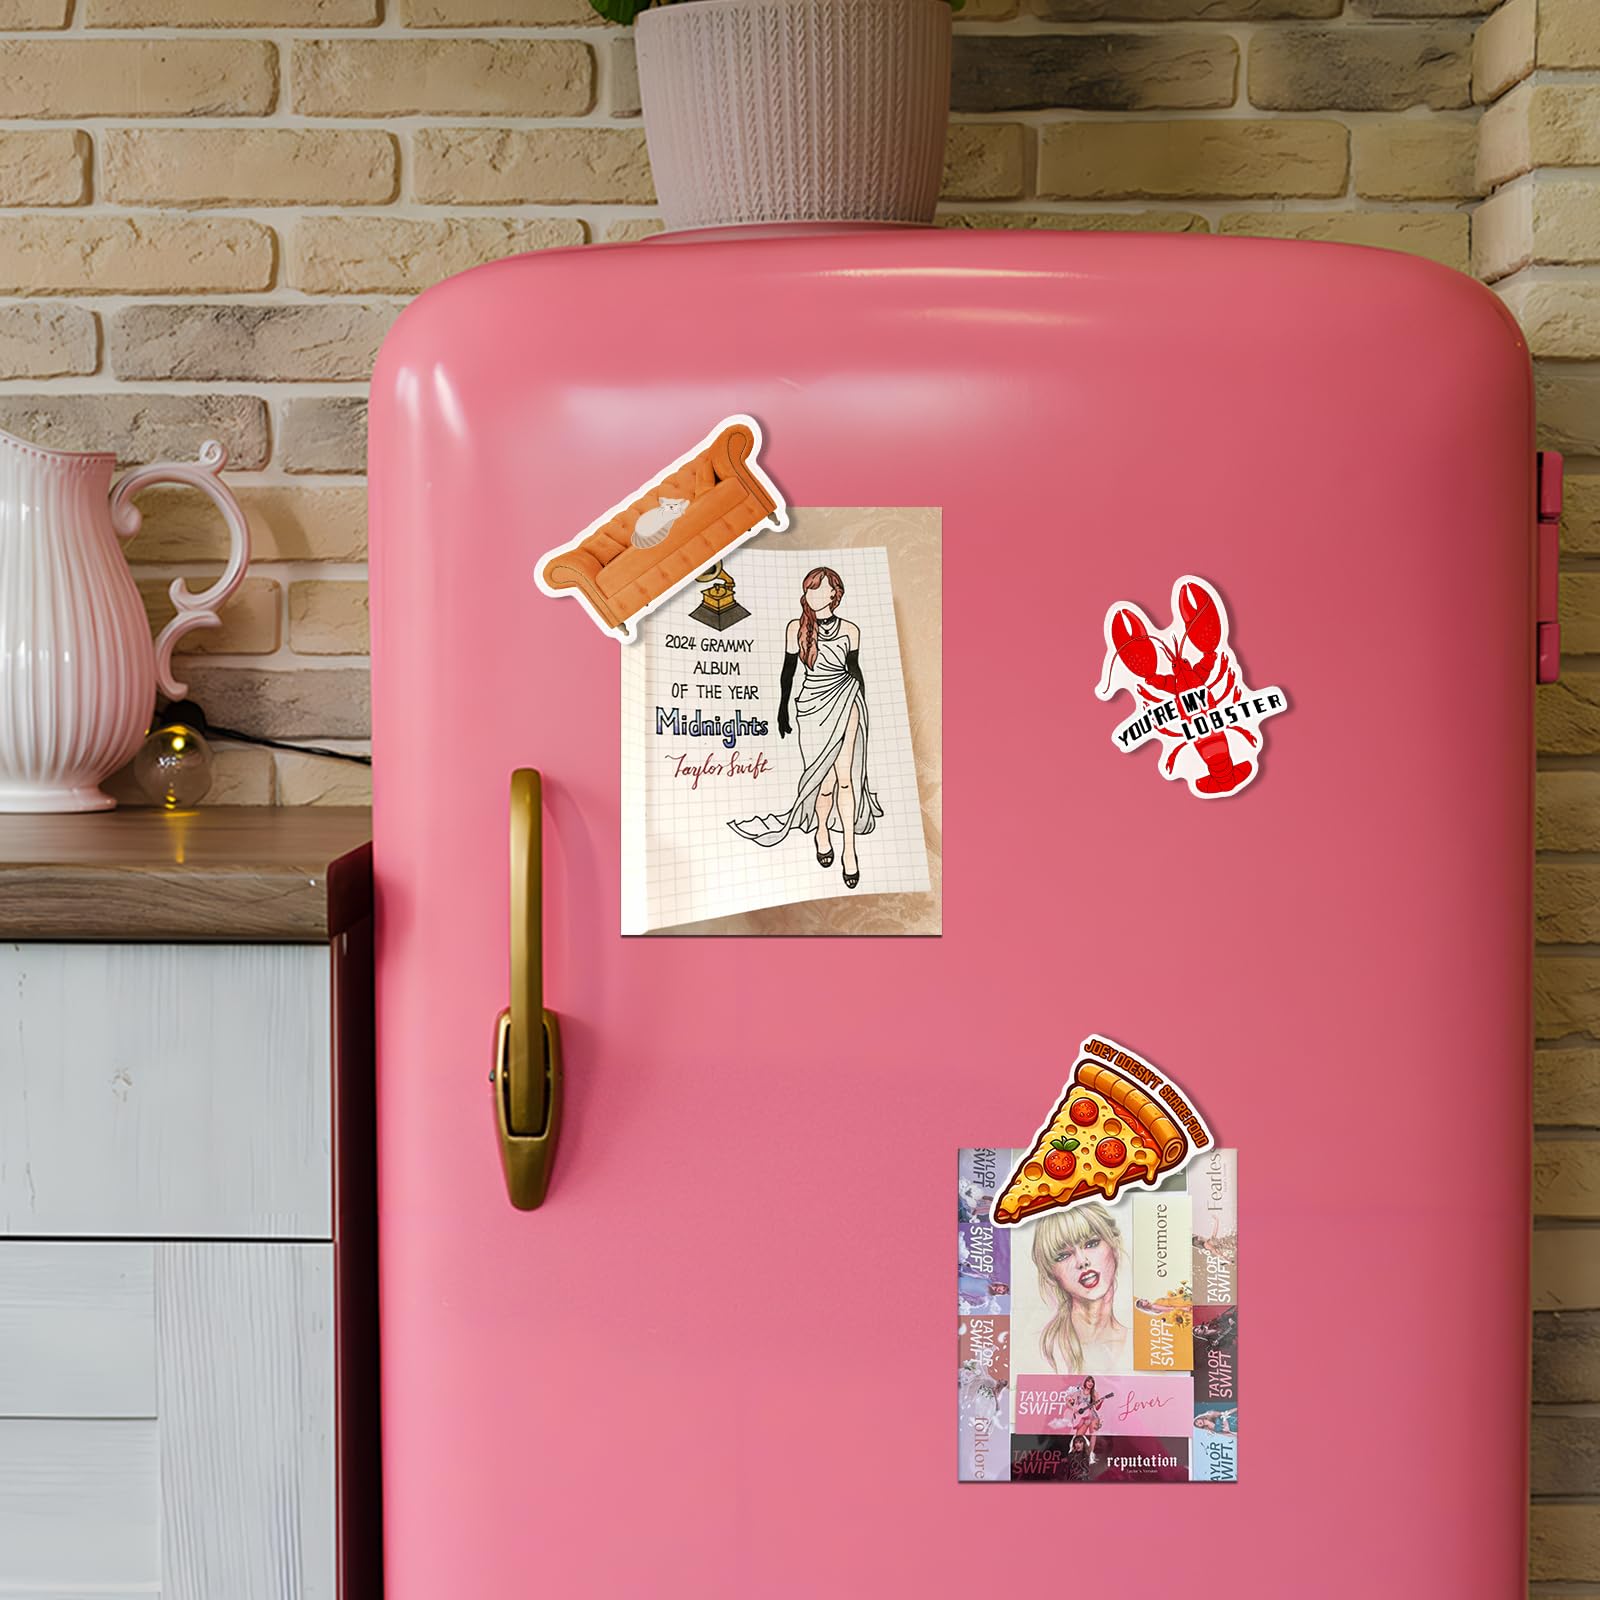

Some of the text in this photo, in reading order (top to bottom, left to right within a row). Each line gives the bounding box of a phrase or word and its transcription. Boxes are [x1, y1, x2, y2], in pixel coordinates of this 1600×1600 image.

[665, 634, 754, 652] 2024 GRAMMY
[693, 661, 740, 675] ALBUM
[671, 682, 759, 700] OF THE YEAR
[655, 706, 769, 748] Midnights
[1118, 688, 1206, 746] YOU'RE MY
[1181, 694, 1282, 741] LOBSTER
[665, 751, 773, 790] Taylor Swift
[1084, 1039, 1209, 1149] JOEY DOESN'T SHARE FOOD
[985, 1148, 996, 1189] AYLOR
[970, 1225, 983, 1272] SWIFT
[982, 1226, 993, 1273] TAYLOR
[1156, 1203, 1168, 1278] evermore
[1207, 1255, 1218, 1303] TAYLOR
[970, 1318, 983, 1367] SWIFT
[982, 1319, 994, 1368] TAYLOR
[1150, 1318, 1161, 1366] TAYLOR
[1161, 1319, 1175, 1367] SWIFT
[1208, 1349, 1219, 1398] TAYLOR
[1219, 1350, 1233, 1399] SWIFT
[1018, 1402, 1066, 1416] SWIFT
[1020, 1390, 1068, 1402] TAYLOR
[1118, 1391, 1174, 1421] Lover
[974, 1416, 992, 1480] folklore
[1012, 1450, 1062, 1461] TAYLOR
[1012, 1461, 1060, 1475] SWIFT
[1107, 1454, 1177, 1472] reputation
[1210, 1442, 1220, 1480] AYLOR
[1221, 1443, 1233, 1480] WIFT
